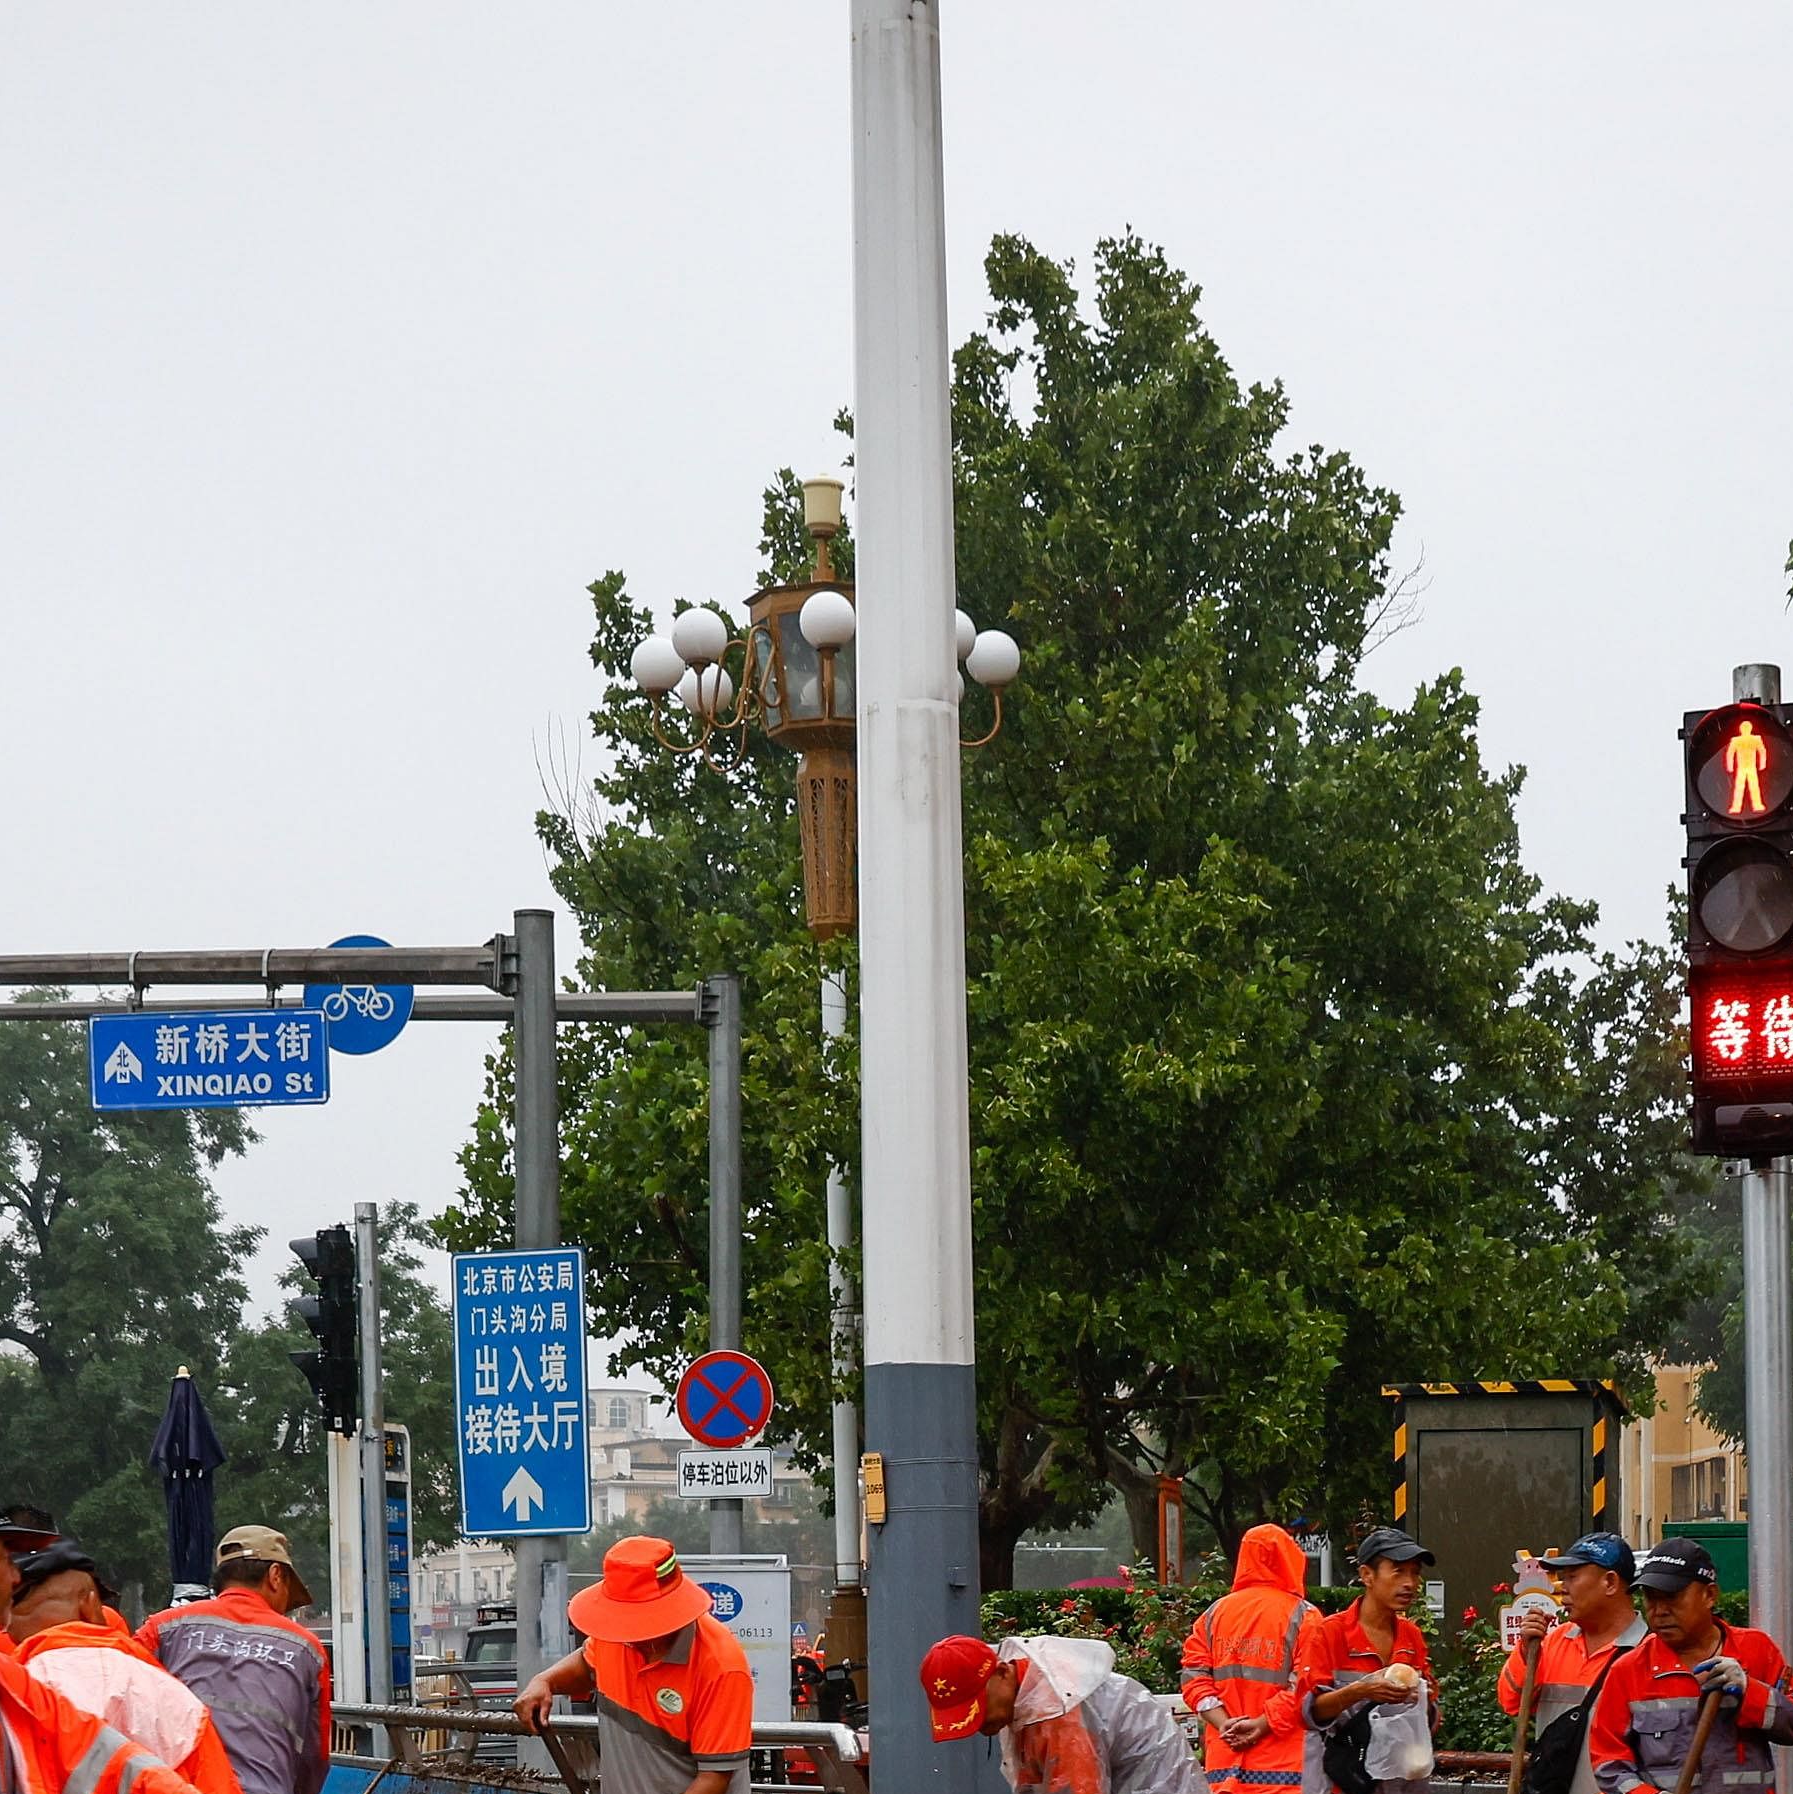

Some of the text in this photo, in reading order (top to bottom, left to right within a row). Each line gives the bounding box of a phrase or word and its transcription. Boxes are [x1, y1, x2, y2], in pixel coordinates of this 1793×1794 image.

[116, 1049, 129, 1067] 北
[155, 1022, 312, 1065] 新桥大街
[157, 1072, 313, 1096] XINQIAO St
[462, 1261, 574, 1296] 北京市公安局
[470, 1302, 567, 1336] 门头沟分局
[475, 1342, 568, 1396] 出入境
[465, 1401, 579, 1455] 接待大厅
[683, 1462, 767, 1487] 停车泊位以外
[866, 1484, 883, 1494] 1069
[711, 1591, 735, 1616] 递
[187, 1631, 295, 1670] 门头沟环卫
